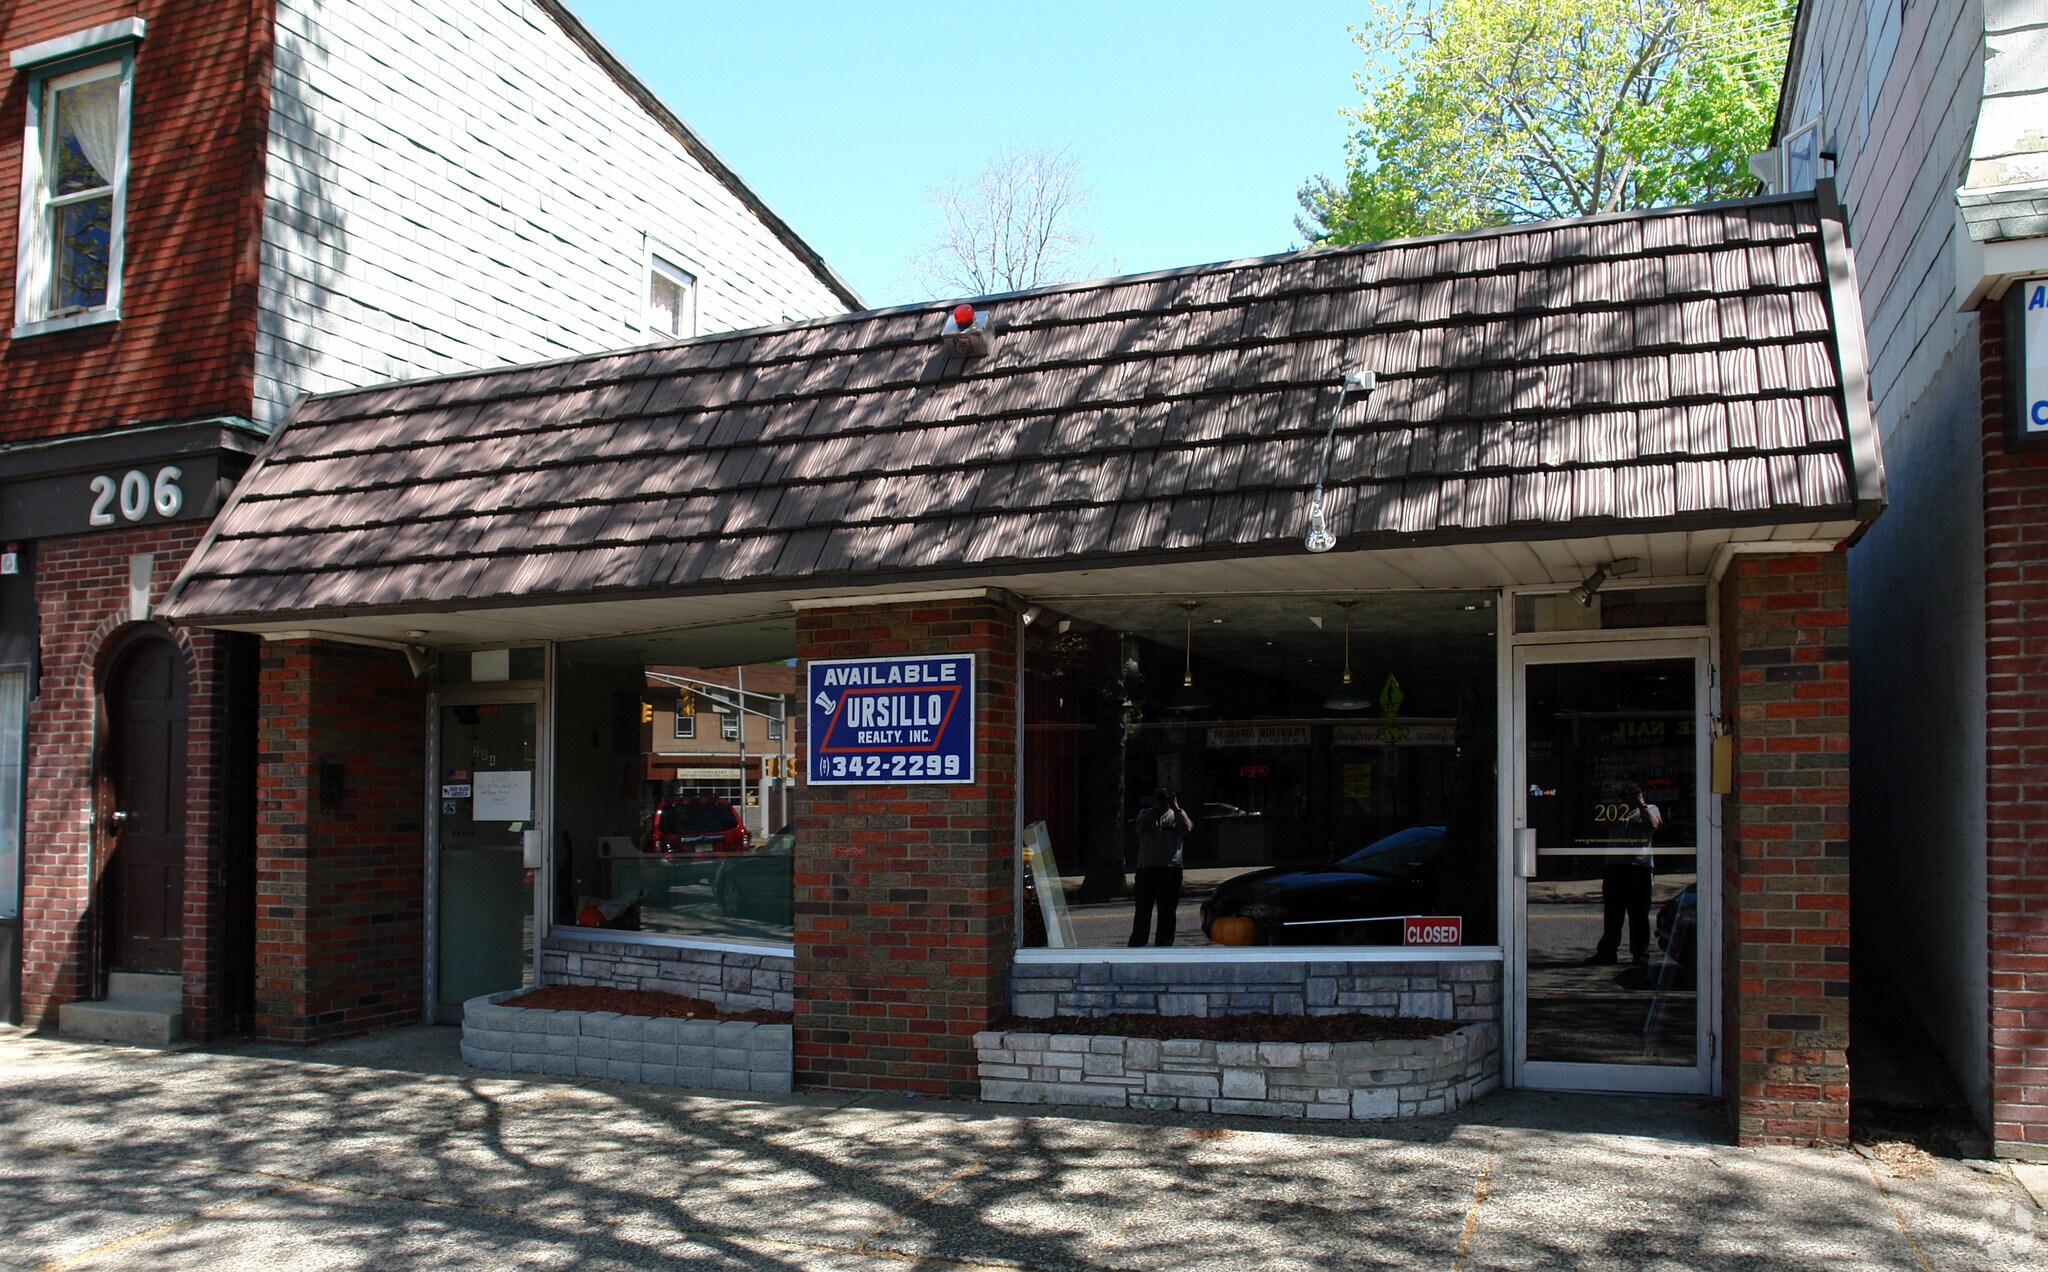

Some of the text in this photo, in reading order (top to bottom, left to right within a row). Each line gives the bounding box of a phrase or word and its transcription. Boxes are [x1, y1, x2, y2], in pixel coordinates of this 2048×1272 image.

[2028, 285, 2048, 311] A
[89, 466, 182, 527] 206
[824, 663, 957, 686] AVAILABLE
[847, 694, 942, 728] URSILLO
[909, 730, 931, 743] INC.
[832, 755, 960, 777] 342-2299
[1595, 804, 1630, 822] 202
[1407, 926, 1458, 943] CLOSED
